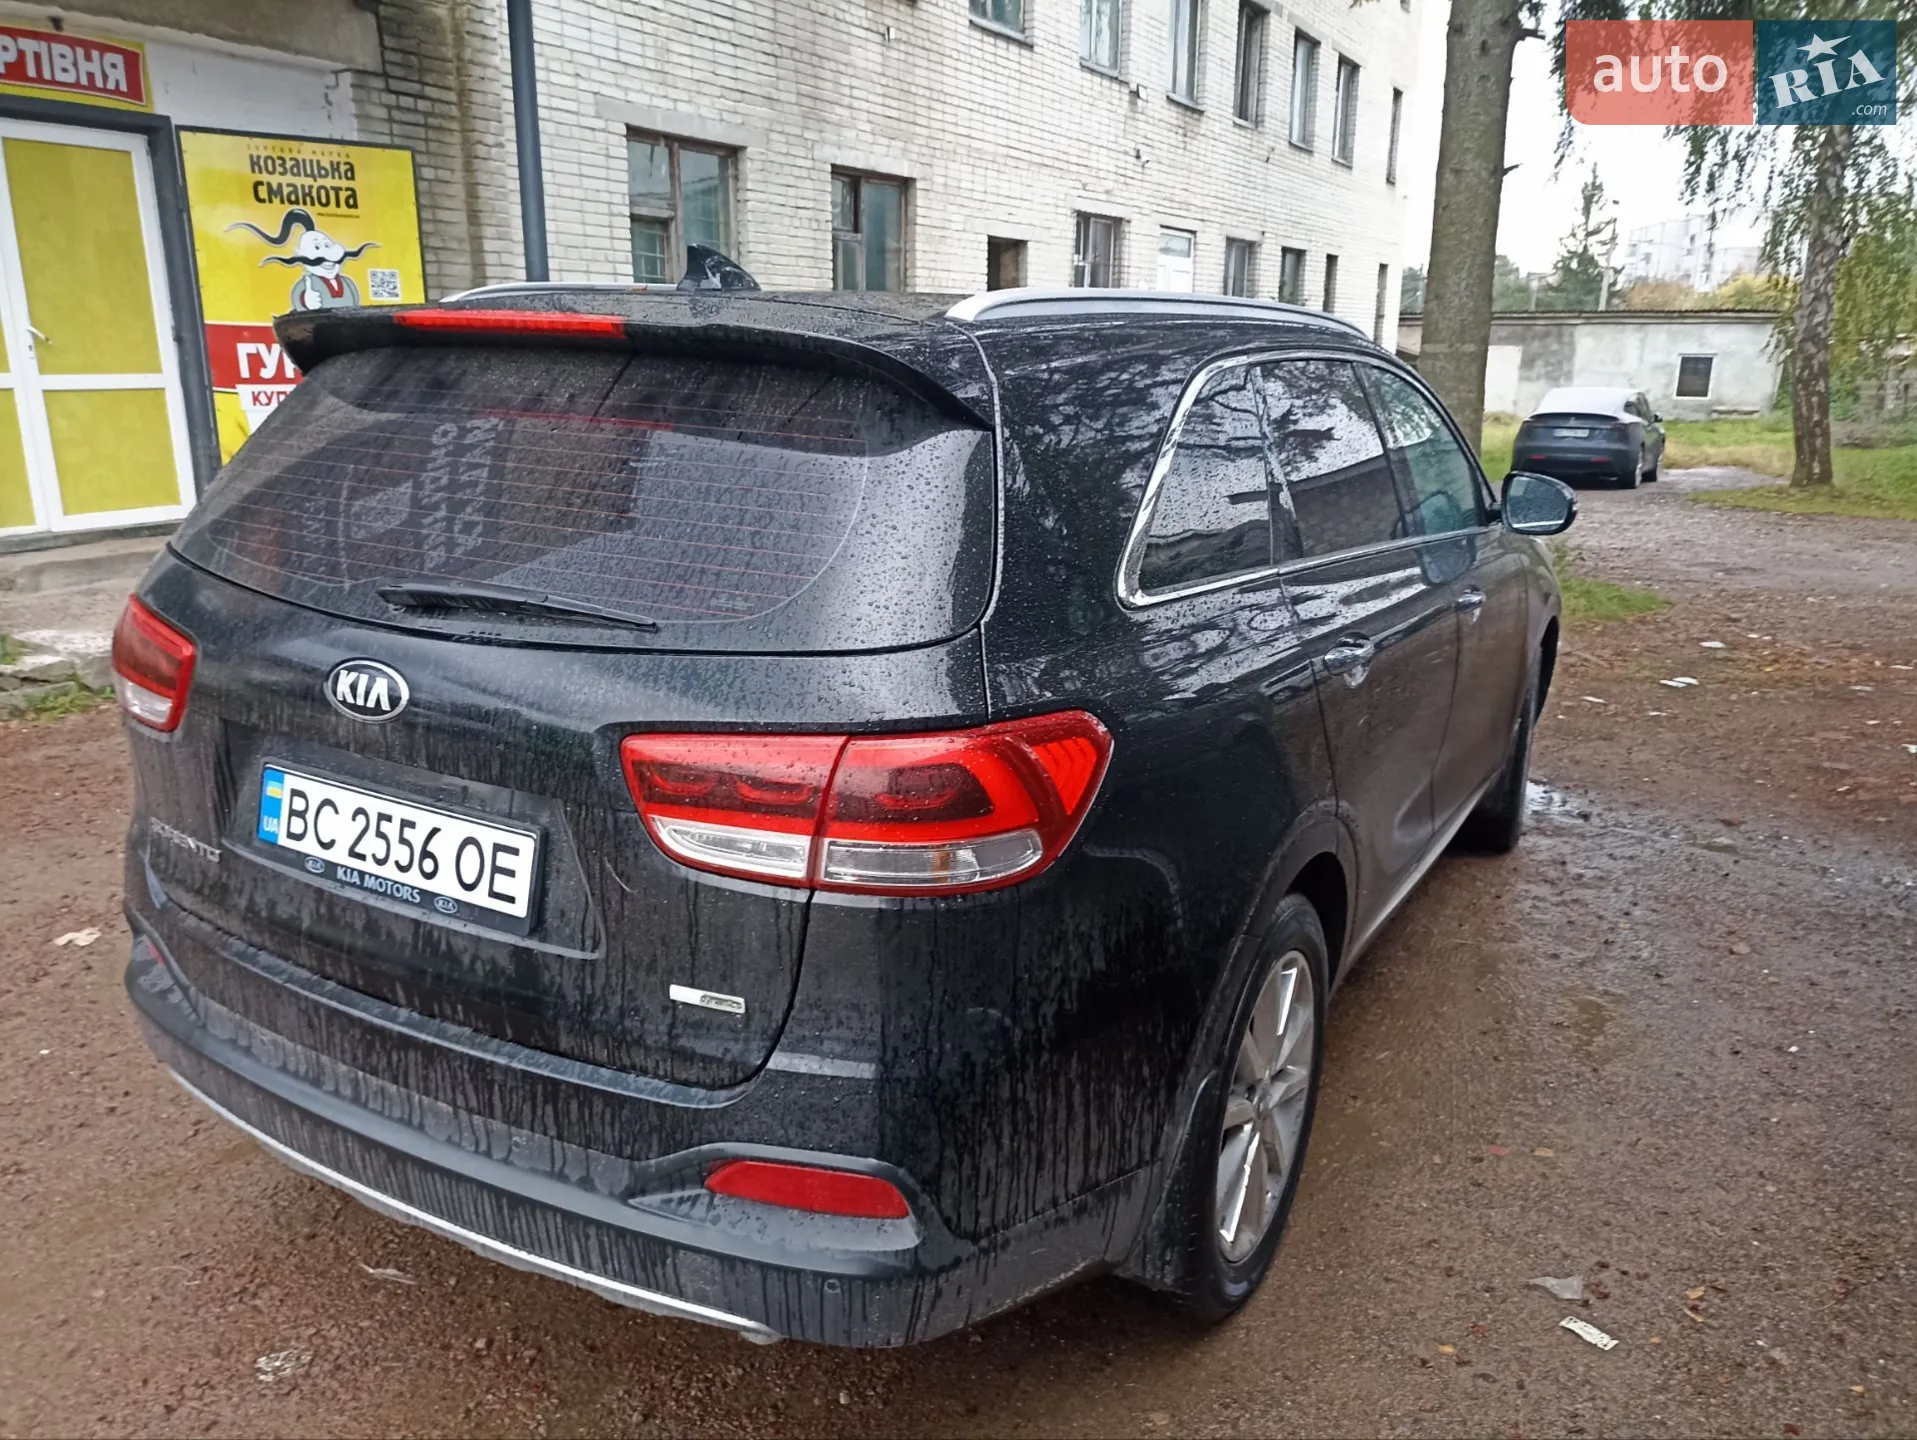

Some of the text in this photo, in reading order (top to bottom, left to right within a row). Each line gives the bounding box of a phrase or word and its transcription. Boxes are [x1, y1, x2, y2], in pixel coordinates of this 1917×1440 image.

[336, 669, 391, 711] KIA
[263, 815, 280, 834] UA
[286, 787, 520, 905] BC 2556 OE
[336, 866, 421, 903] KIA MOTORS
